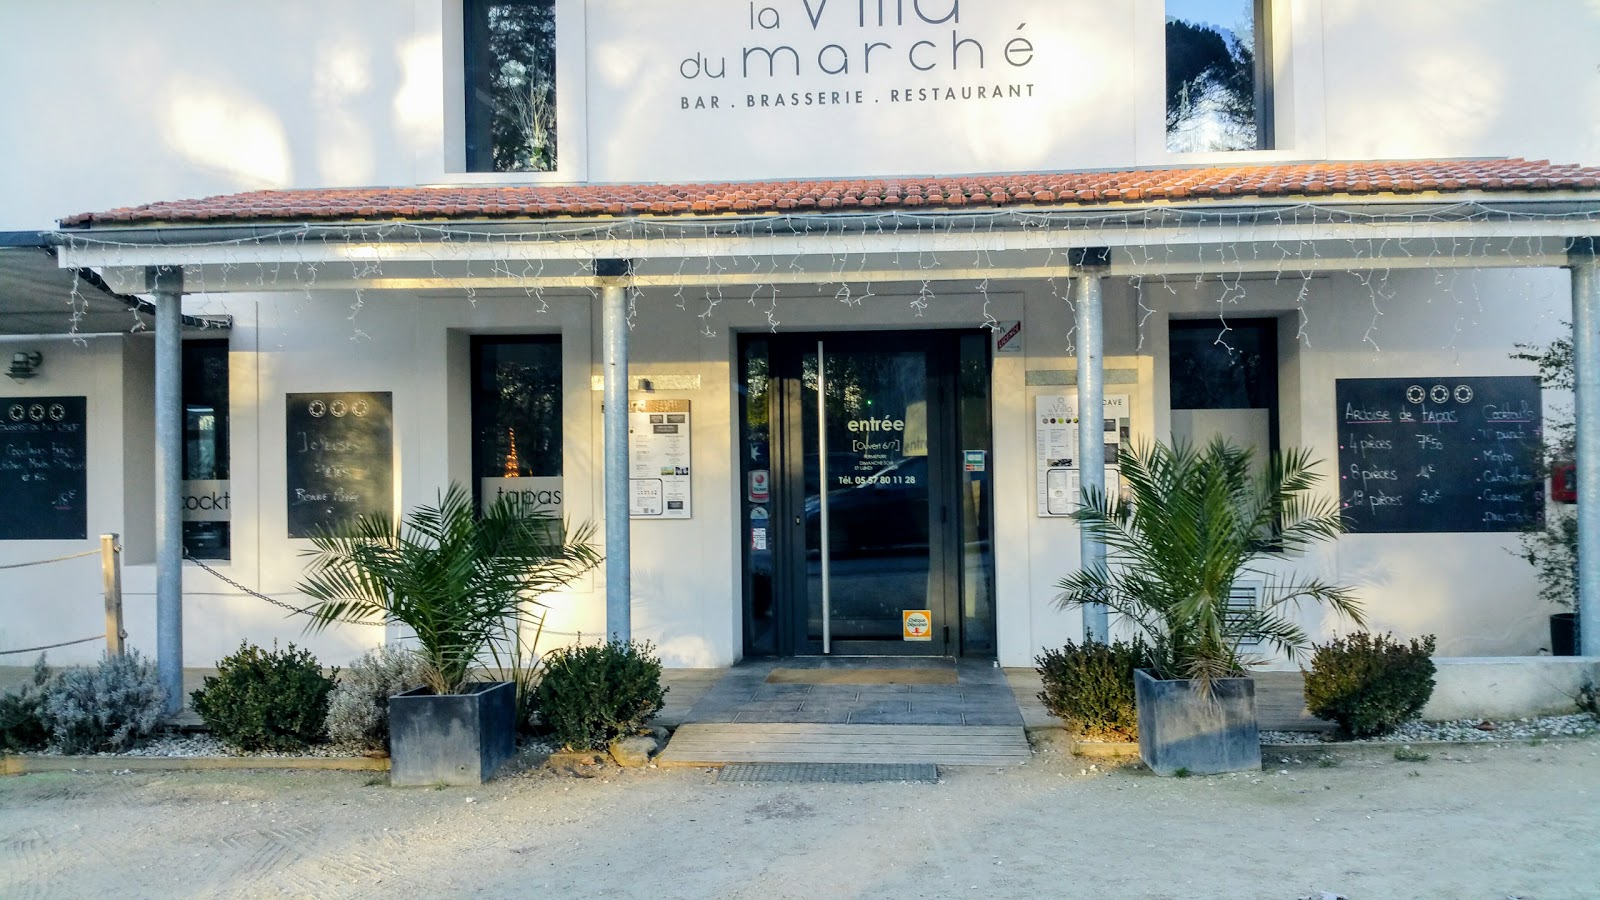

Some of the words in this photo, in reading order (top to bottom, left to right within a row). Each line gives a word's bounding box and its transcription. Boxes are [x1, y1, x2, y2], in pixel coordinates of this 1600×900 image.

[750, 1, 780, 30] la
[680, 52, 726, 79] du
[743, 23, 1034, 78] marché
[681, 96, 720, 110] BAR
[747, 90, 863, 108] BRASSERIE
[890, 84, 1035, 103] RESTAURANT
[847, 414, 905, 432] entrée
[1399, 405, 1416, 421] de
[1349, 433, 1357, 453] 4
[1360, 434, 1393, 458] pièces
[838, 475, 853, 484] Tél.
[855, 476, 866, 484] 05
[867, 476, 879, 484] 57
[880, 476, 891, 484] 80
[893, 476, 902, 484] 11
[904, 475, 916, 484] 28
[1350, 464, 1360, 479] 8
[1362, 464, 1398, 491] pièces
[1369, 489, 1403, 515] pièces
